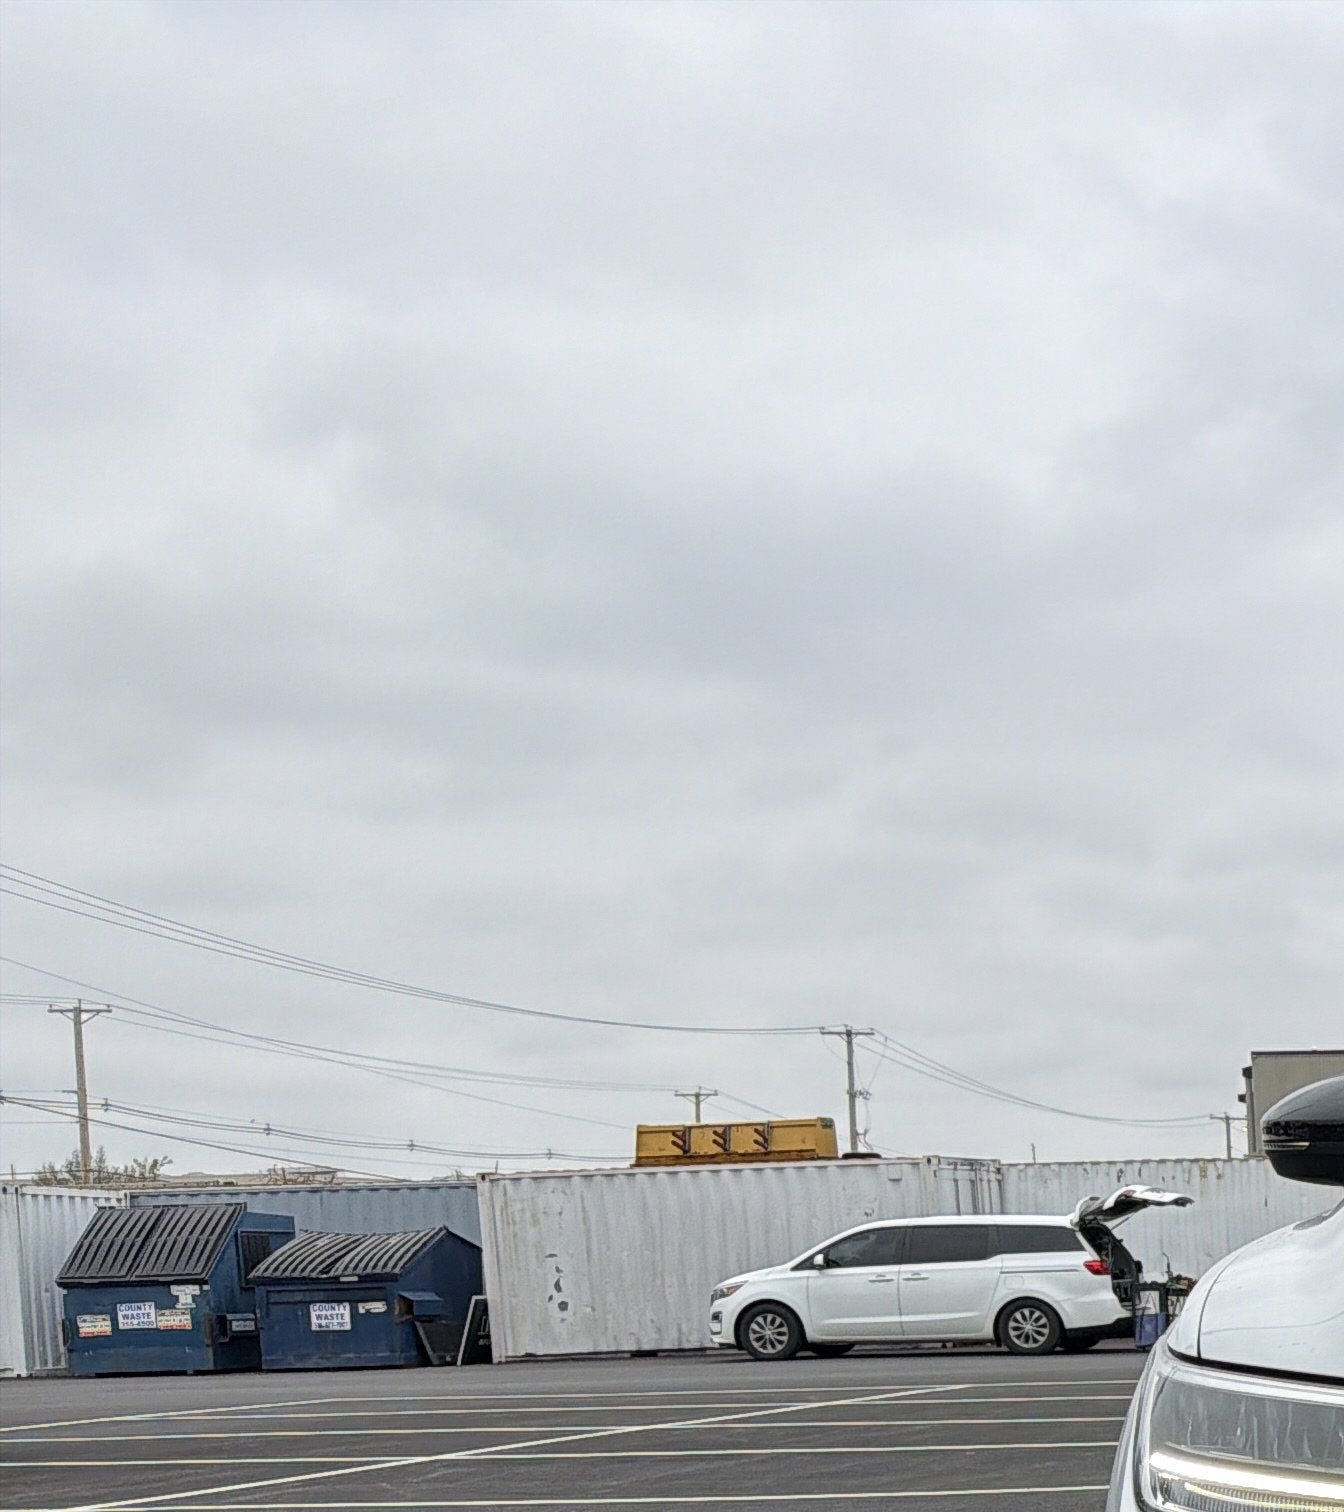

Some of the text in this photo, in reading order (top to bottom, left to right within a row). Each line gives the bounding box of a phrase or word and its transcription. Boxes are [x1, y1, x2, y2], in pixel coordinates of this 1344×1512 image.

[118, 1303, 153, 1313] COUNTY
[312, 1303, 347, 1312] COUNTY
[121, 1312, 151, 1321] WASTE
[314, 1312, 346, 1321] WASTE
